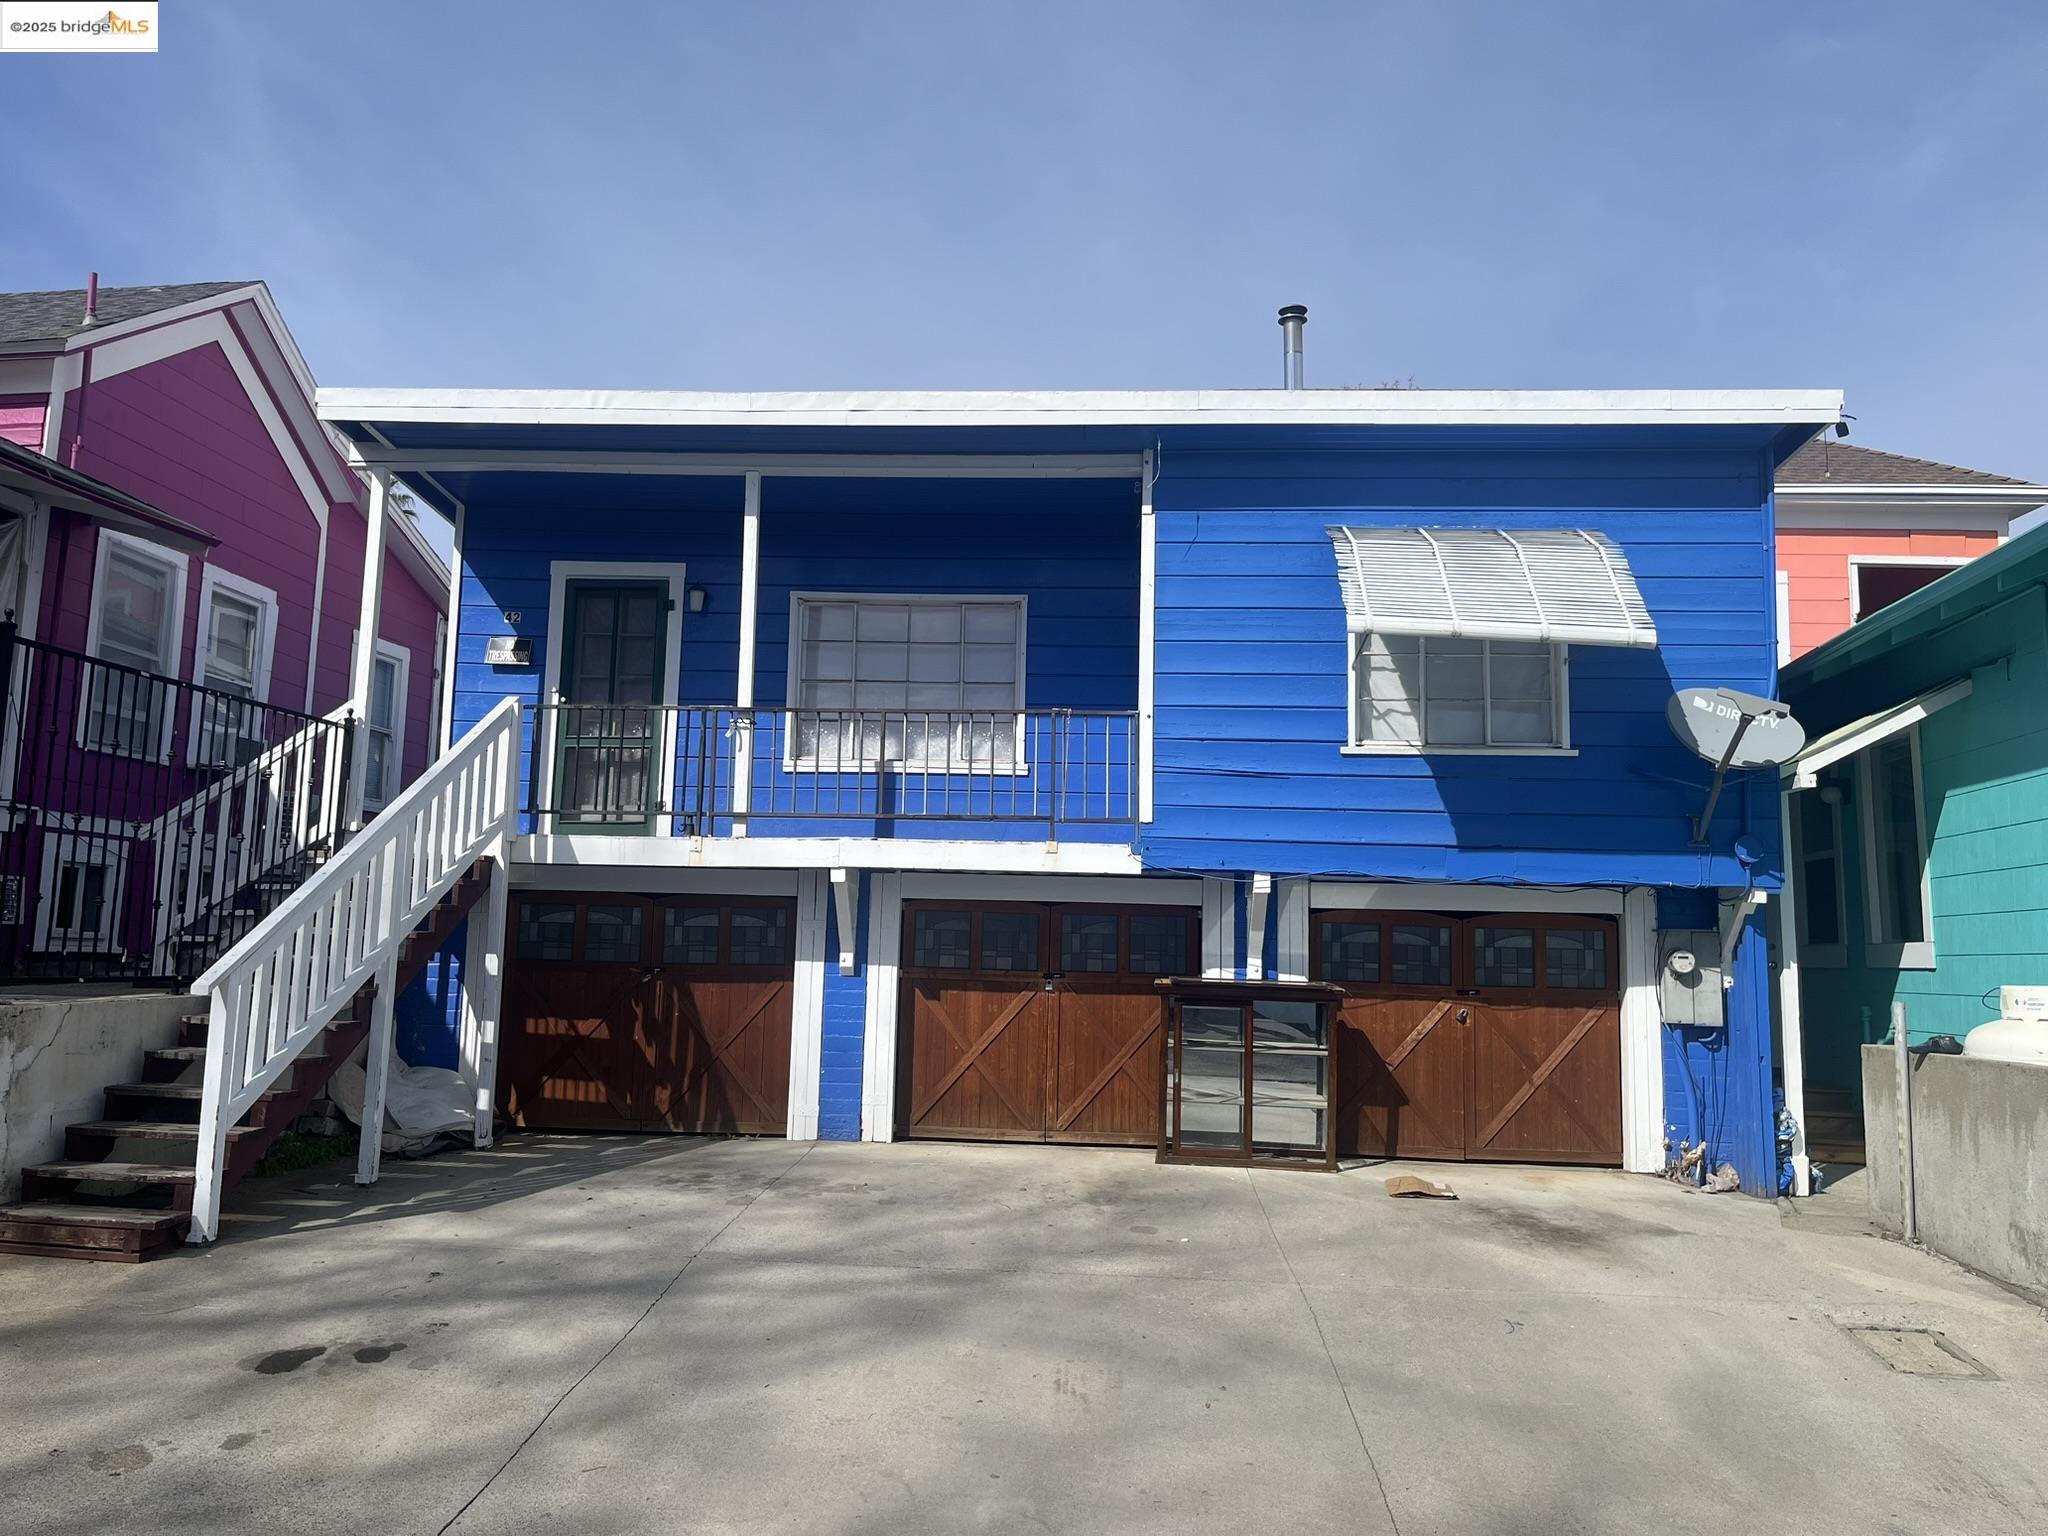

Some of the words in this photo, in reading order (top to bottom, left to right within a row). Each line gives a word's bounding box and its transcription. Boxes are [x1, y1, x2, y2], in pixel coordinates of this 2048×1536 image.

[505, 612, 520, 623] 42
[504, 639, 515, 650] NO
[488, 650, 529, 662] TRESPASSING
[1716, 704, 1780, 729] DIRCTV
